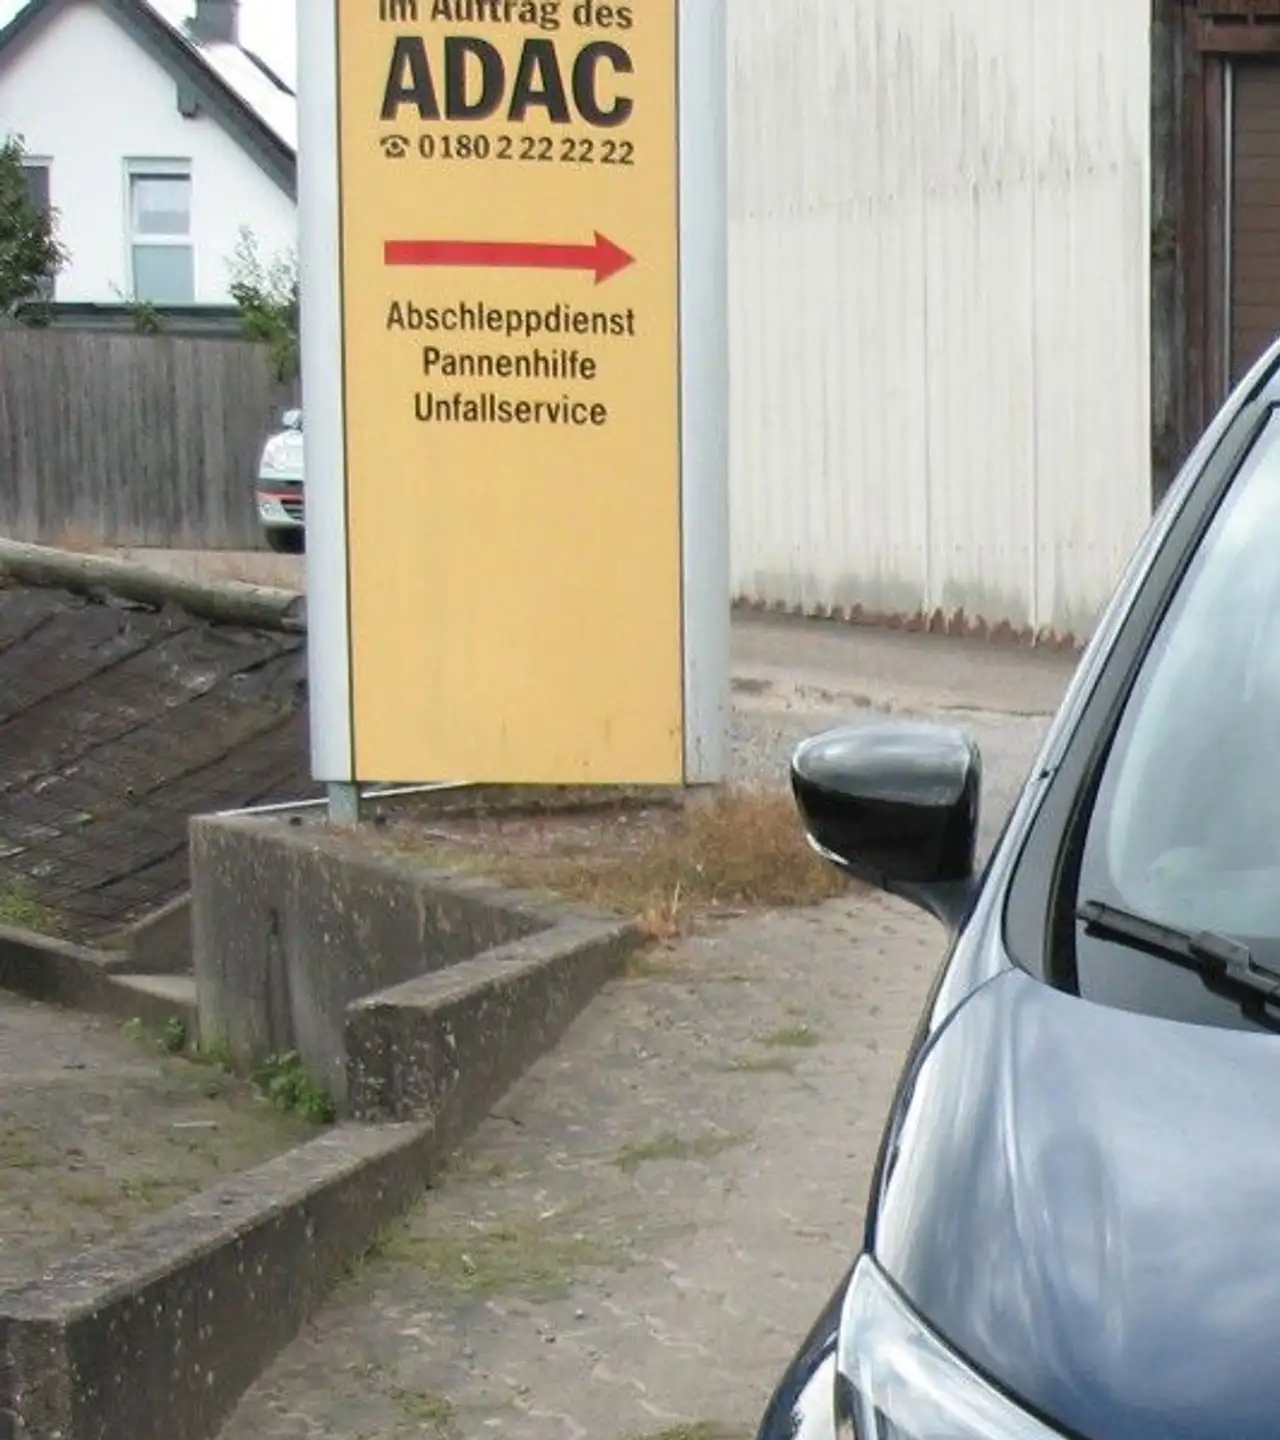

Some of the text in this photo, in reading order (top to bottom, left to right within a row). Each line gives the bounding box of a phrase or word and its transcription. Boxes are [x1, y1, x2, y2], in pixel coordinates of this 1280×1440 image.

[431, 0, 560, 30] Auftrag
[573, 0, 634, 29] des
[380, 35, 635, 128] ADAC
[386, 301, 636, 337] Abschleppdienst
[423, 346, 597, 380] Pannenhilfe
[414, 392, 608, 426] Unfallservice
